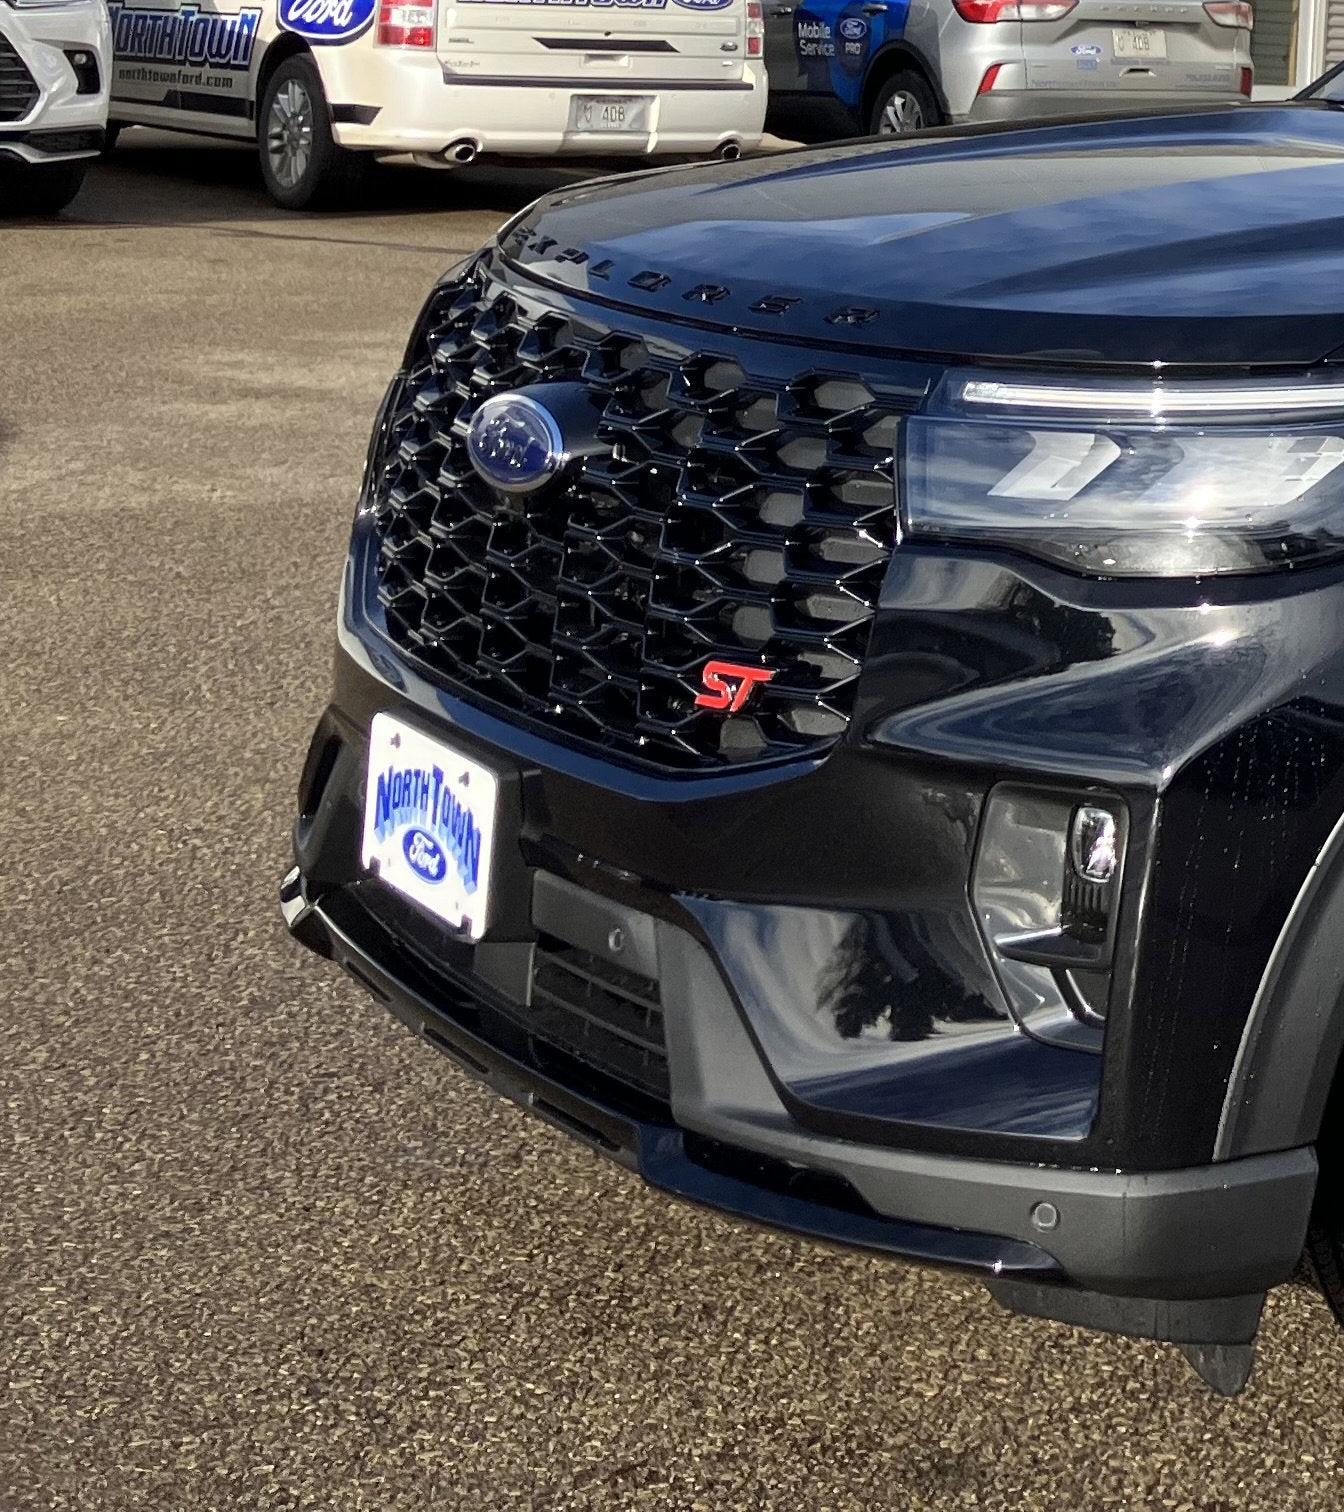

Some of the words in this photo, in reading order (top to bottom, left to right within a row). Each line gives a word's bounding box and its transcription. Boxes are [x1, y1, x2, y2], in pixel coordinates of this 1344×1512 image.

[798, 21, 831, 38] Mobile
[800, 39, 835, 56] Service
[118, 67, 234, 89] northtownford.com
[694, 660, 777, 712] ST
[409, 831, 442, 878] Ford
